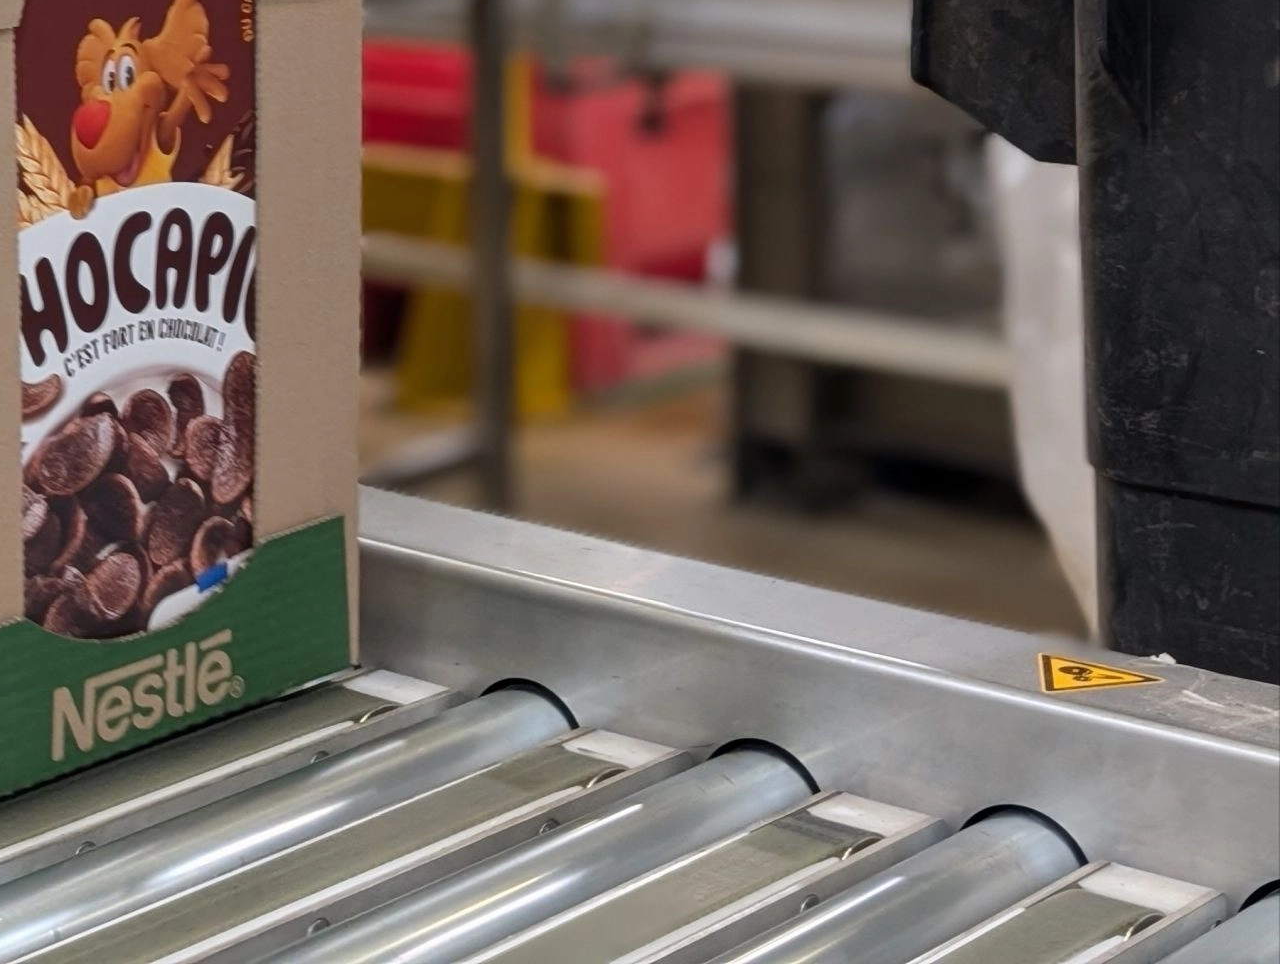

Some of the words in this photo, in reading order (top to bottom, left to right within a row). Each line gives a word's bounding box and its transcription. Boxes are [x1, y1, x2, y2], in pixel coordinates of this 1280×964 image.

[21, 207, 257, 367] HOCAPI
[63, 338, 100, 378] C'EST
[138, 319, 156, 341] EN
